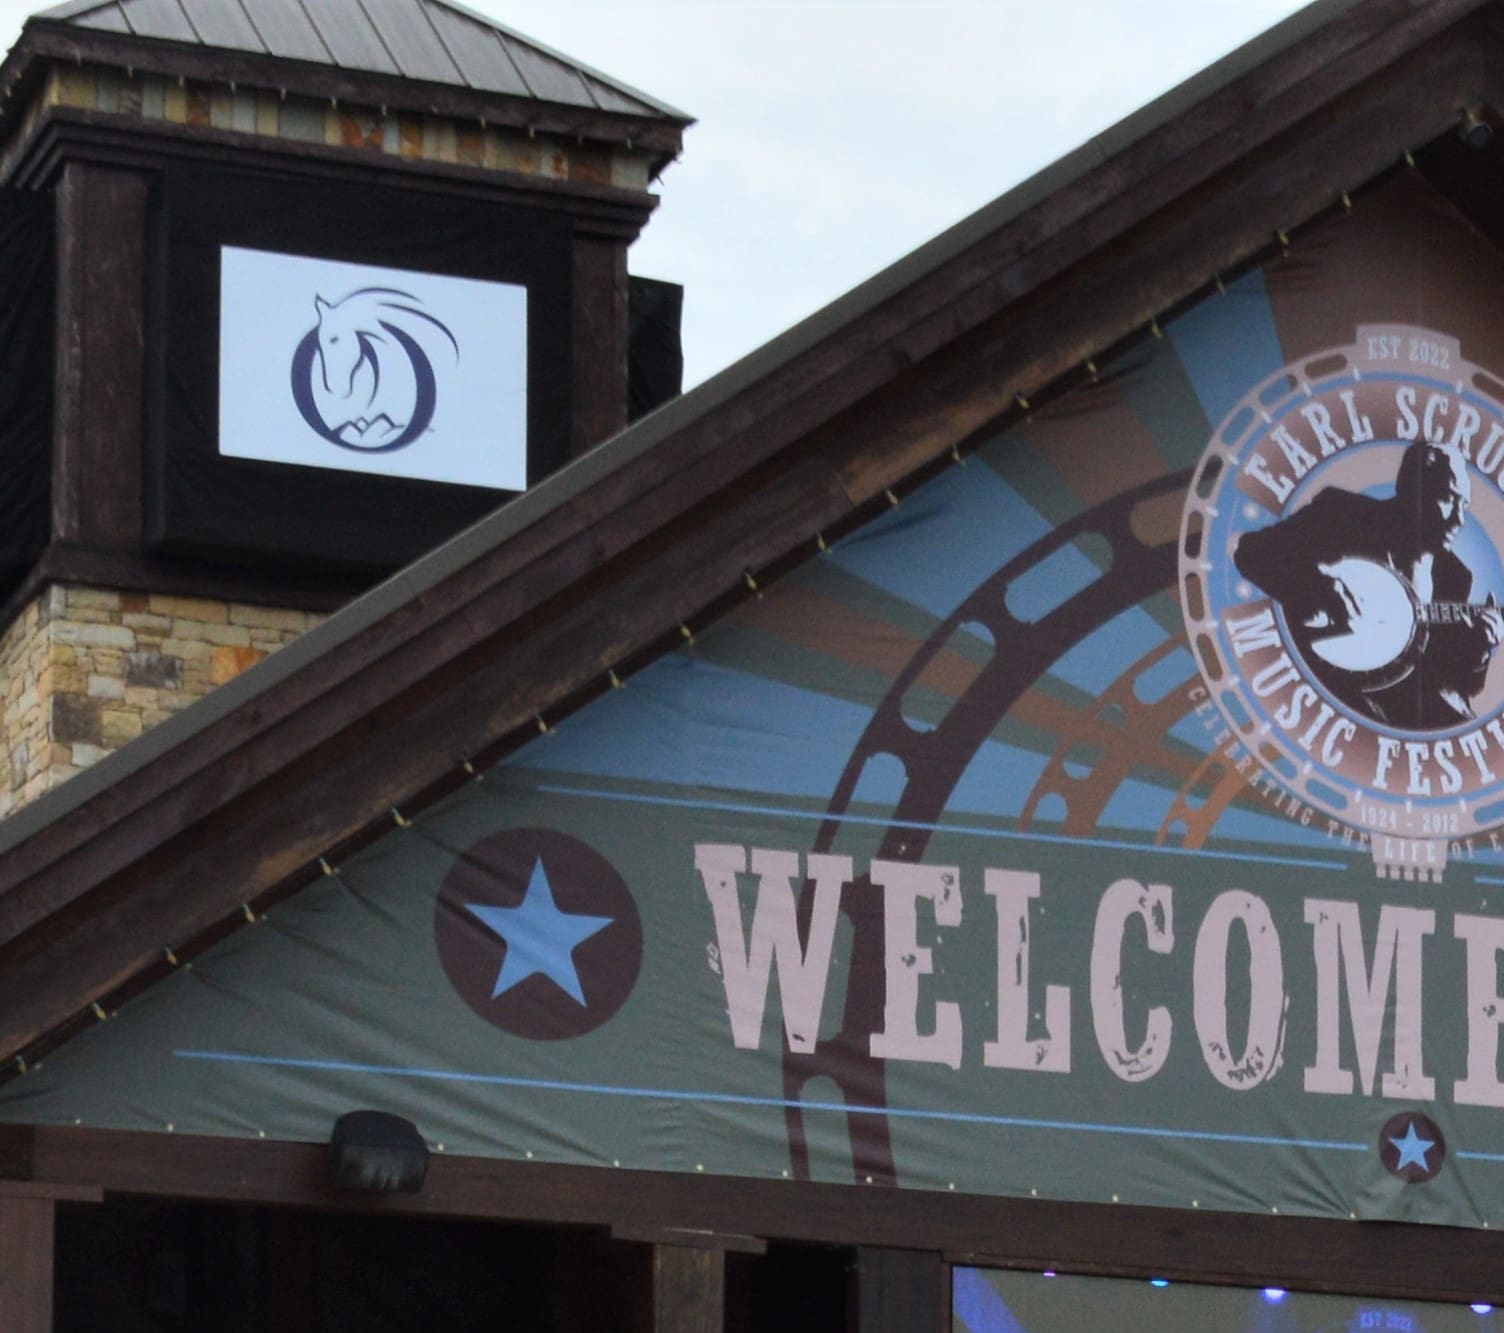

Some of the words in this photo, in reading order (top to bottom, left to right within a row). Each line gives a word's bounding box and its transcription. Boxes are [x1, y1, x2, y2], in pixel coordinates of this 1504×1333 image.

[1367, 337, 1401, 359] EST
[1408, 338, 1451, 370] 2022
[1243, 390, 1375, 504] EARL
[1225, 607, 1357, 767] MUSIC
[1187, 684, 1311, 827] CELEBRATING
[1327, 818, 1373, 852] THE
[1382, 838, 1438, 864] LIFE
[1451, 836, 1476, 860] OF
[1360, 802, 1397, 827] 1924
[1422, 810, 1460, 834] 2012
